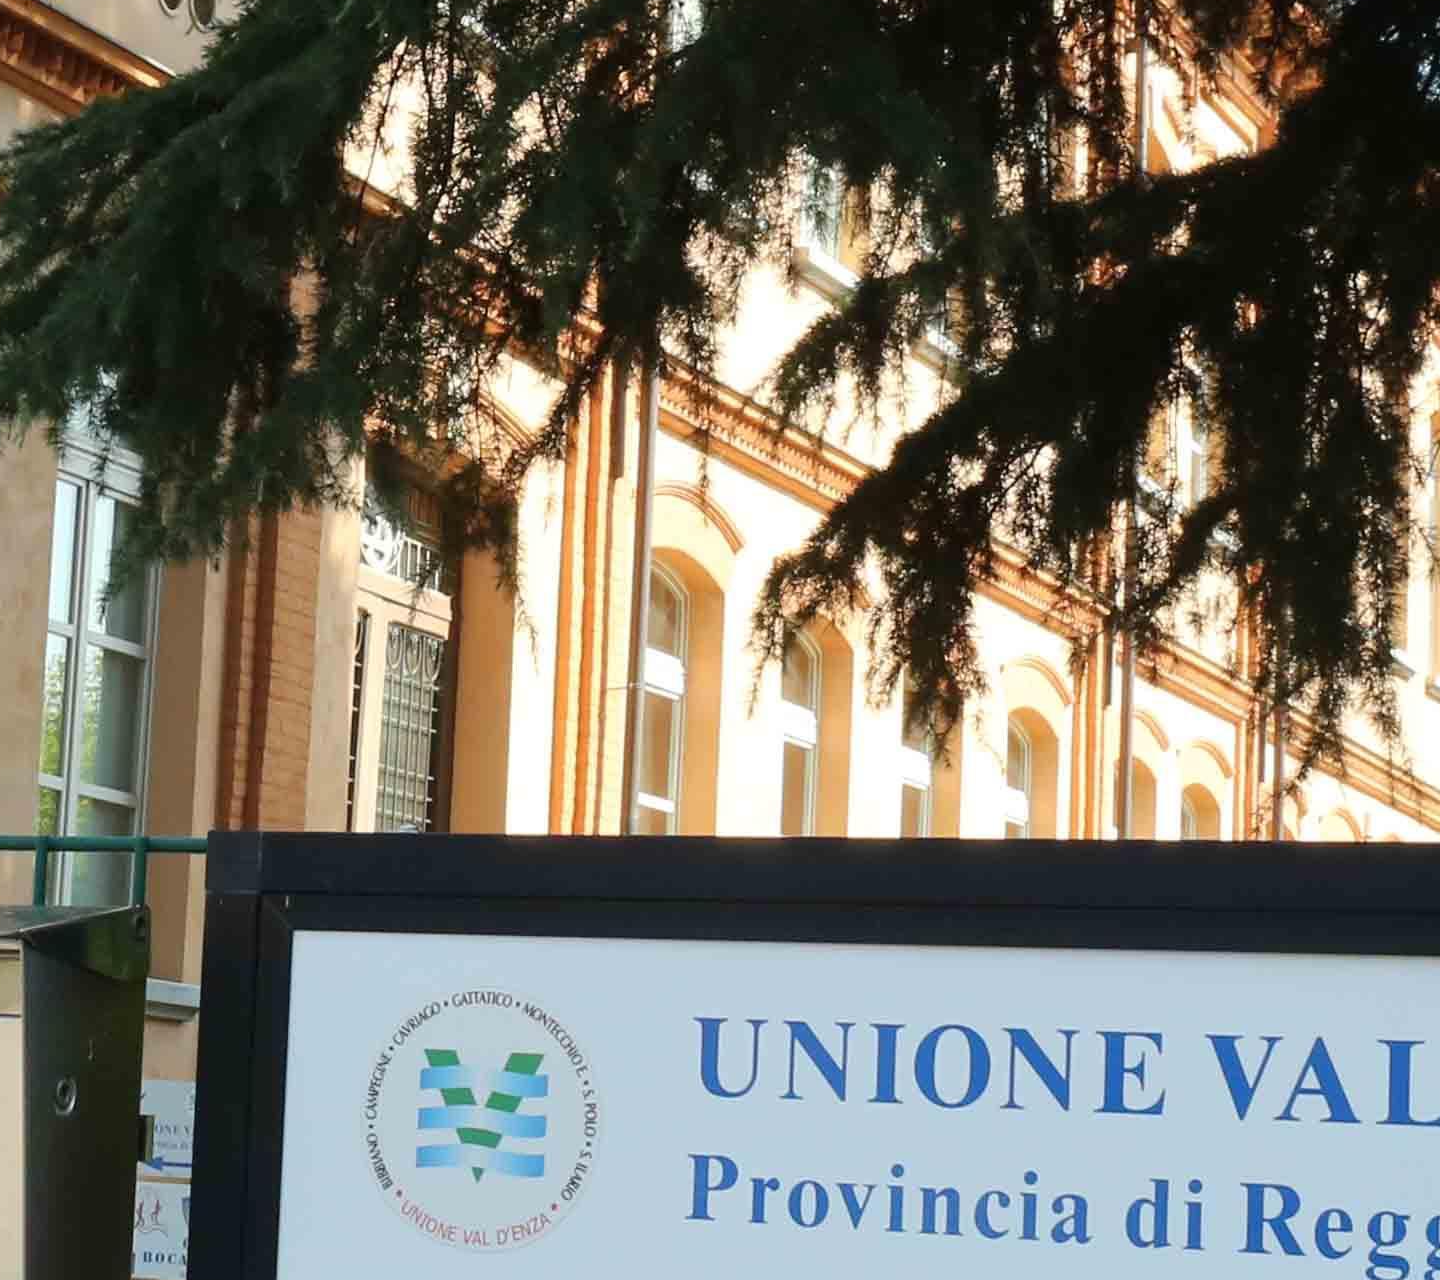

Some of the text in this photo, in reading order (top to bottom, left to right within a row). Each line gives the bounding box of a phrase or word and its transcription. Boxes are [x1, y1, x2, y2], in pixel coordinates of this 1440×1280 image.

[392, 1002, 440, 1045] CAVRIAGO
[452, 991, 513, 1008] GATTATICO
[524, 1002, 583, 1065] MONTECCHIO
[366, 1053, 392, 1120] CAMPEGINE
[694, 1018, 1165, 1115] UNIONE
[584, 1103, 597, 1137] POLO
[366, 1133, 393, 1190] BIBBIANO
[561, 1162, 587, 1200] ILARIO
[401, 1199, 551, 1246] UNIONE VAL D'ENZA
[686, 1155, 1090, 1244] Provincia
[1126, 1179, 1204, 1250] di
